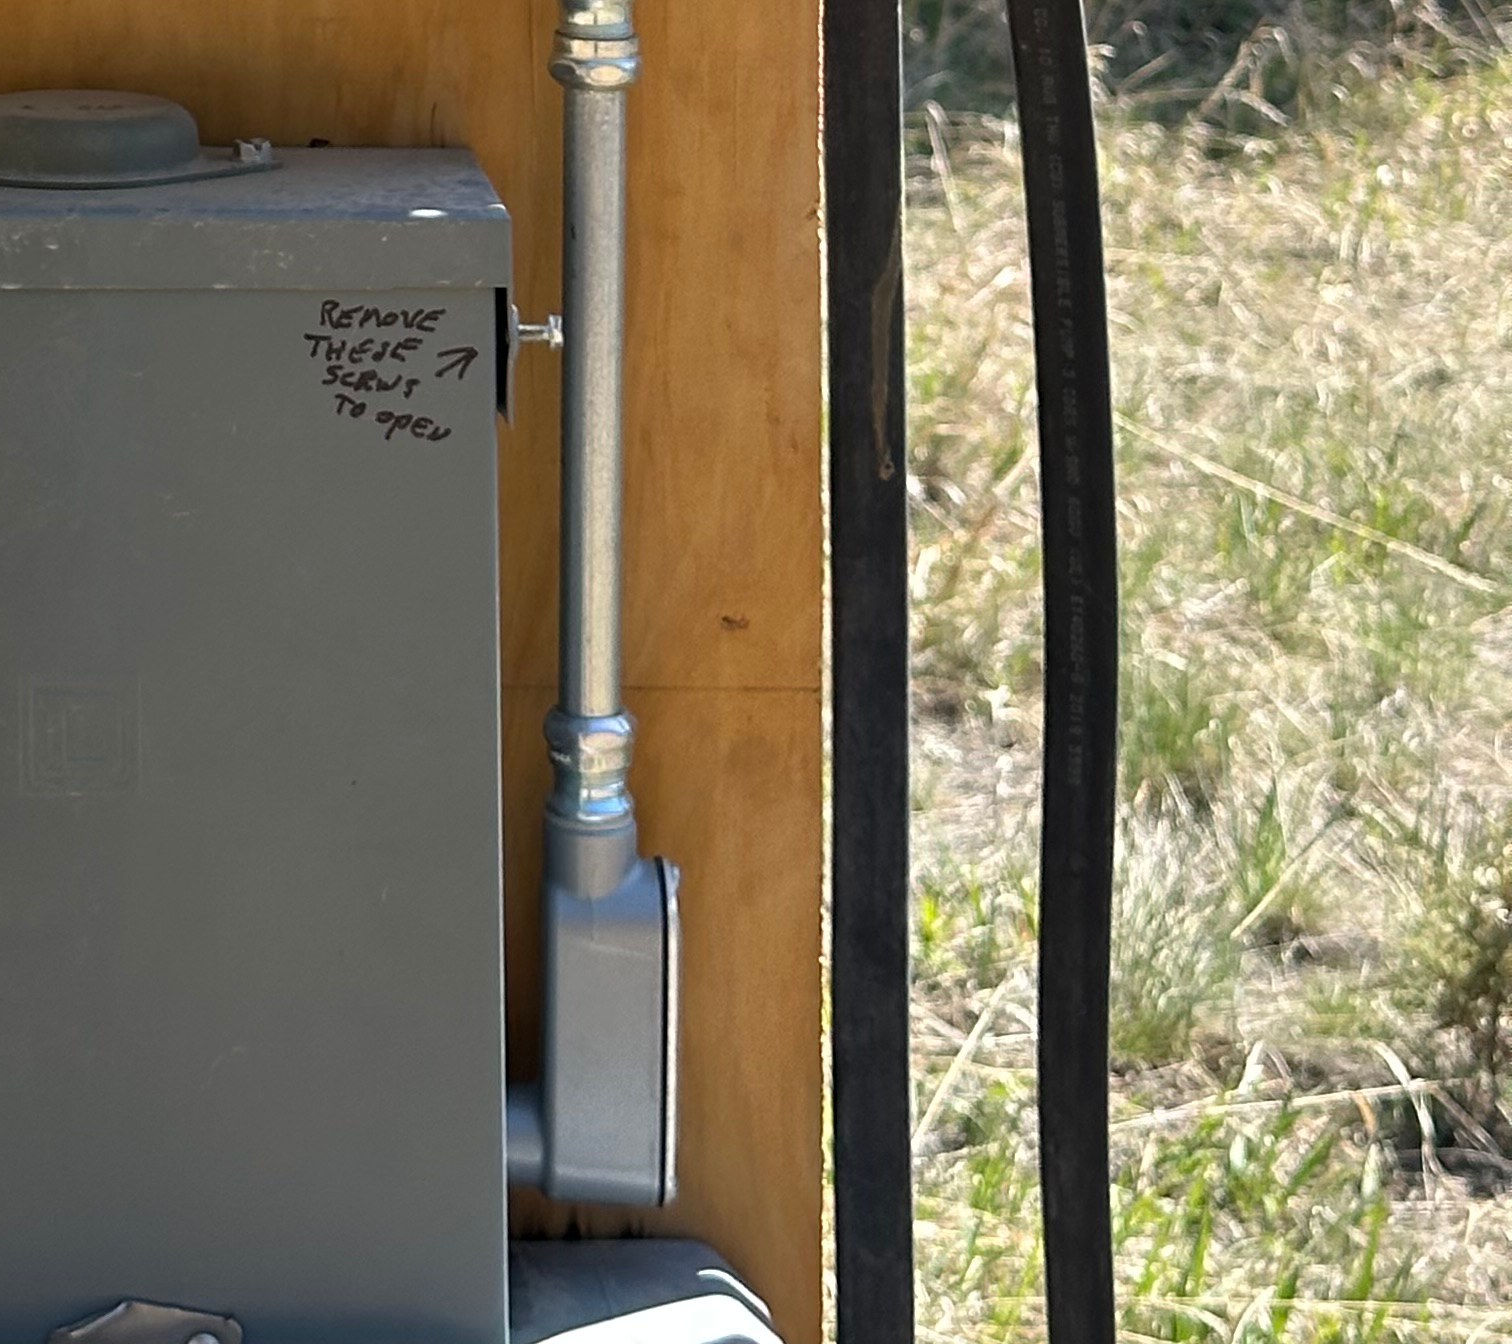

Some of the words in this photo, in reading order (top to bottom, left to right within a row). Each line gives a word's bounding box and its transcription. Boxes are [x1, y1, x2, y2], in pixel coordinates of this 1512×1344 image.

[319, 299, 447, 332] REMOVE
[303, 332, 423, 364] THESE
[334, 393, 367, 419] TO
